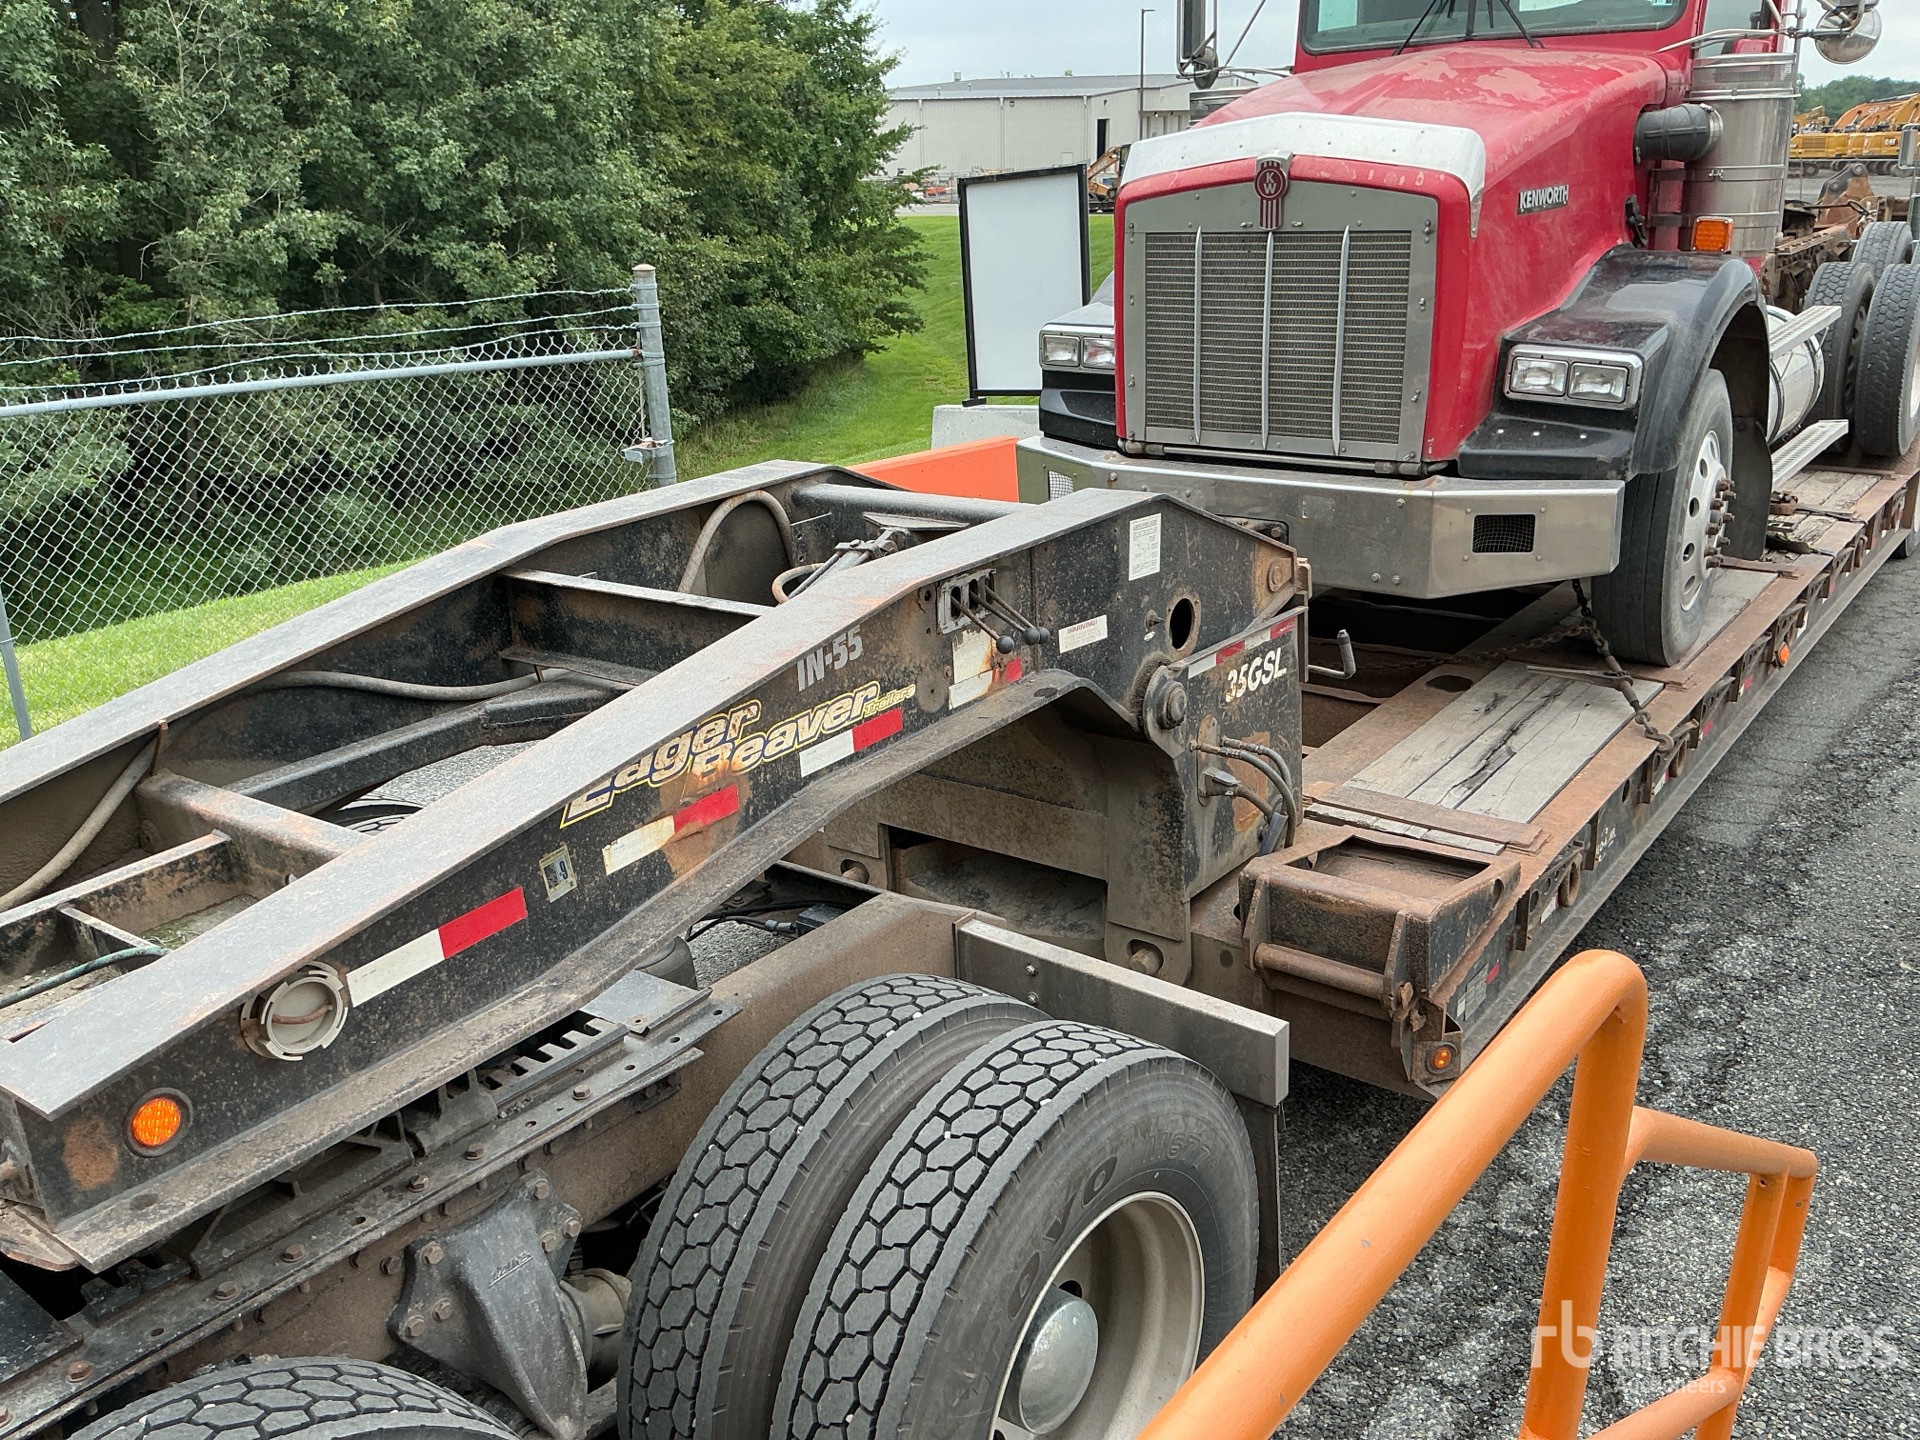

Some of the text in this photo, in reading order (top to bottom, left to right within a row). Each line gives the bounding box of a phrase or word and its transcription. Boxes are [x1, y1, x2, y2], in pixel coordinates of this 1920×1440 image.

[1520, 184, 1569, 209] KENWORTH
[798, 625, 864, 691] IN-55
[1225, 647, 1287, 703] 35GSL
[693, 681, 880, 784] Beaver
